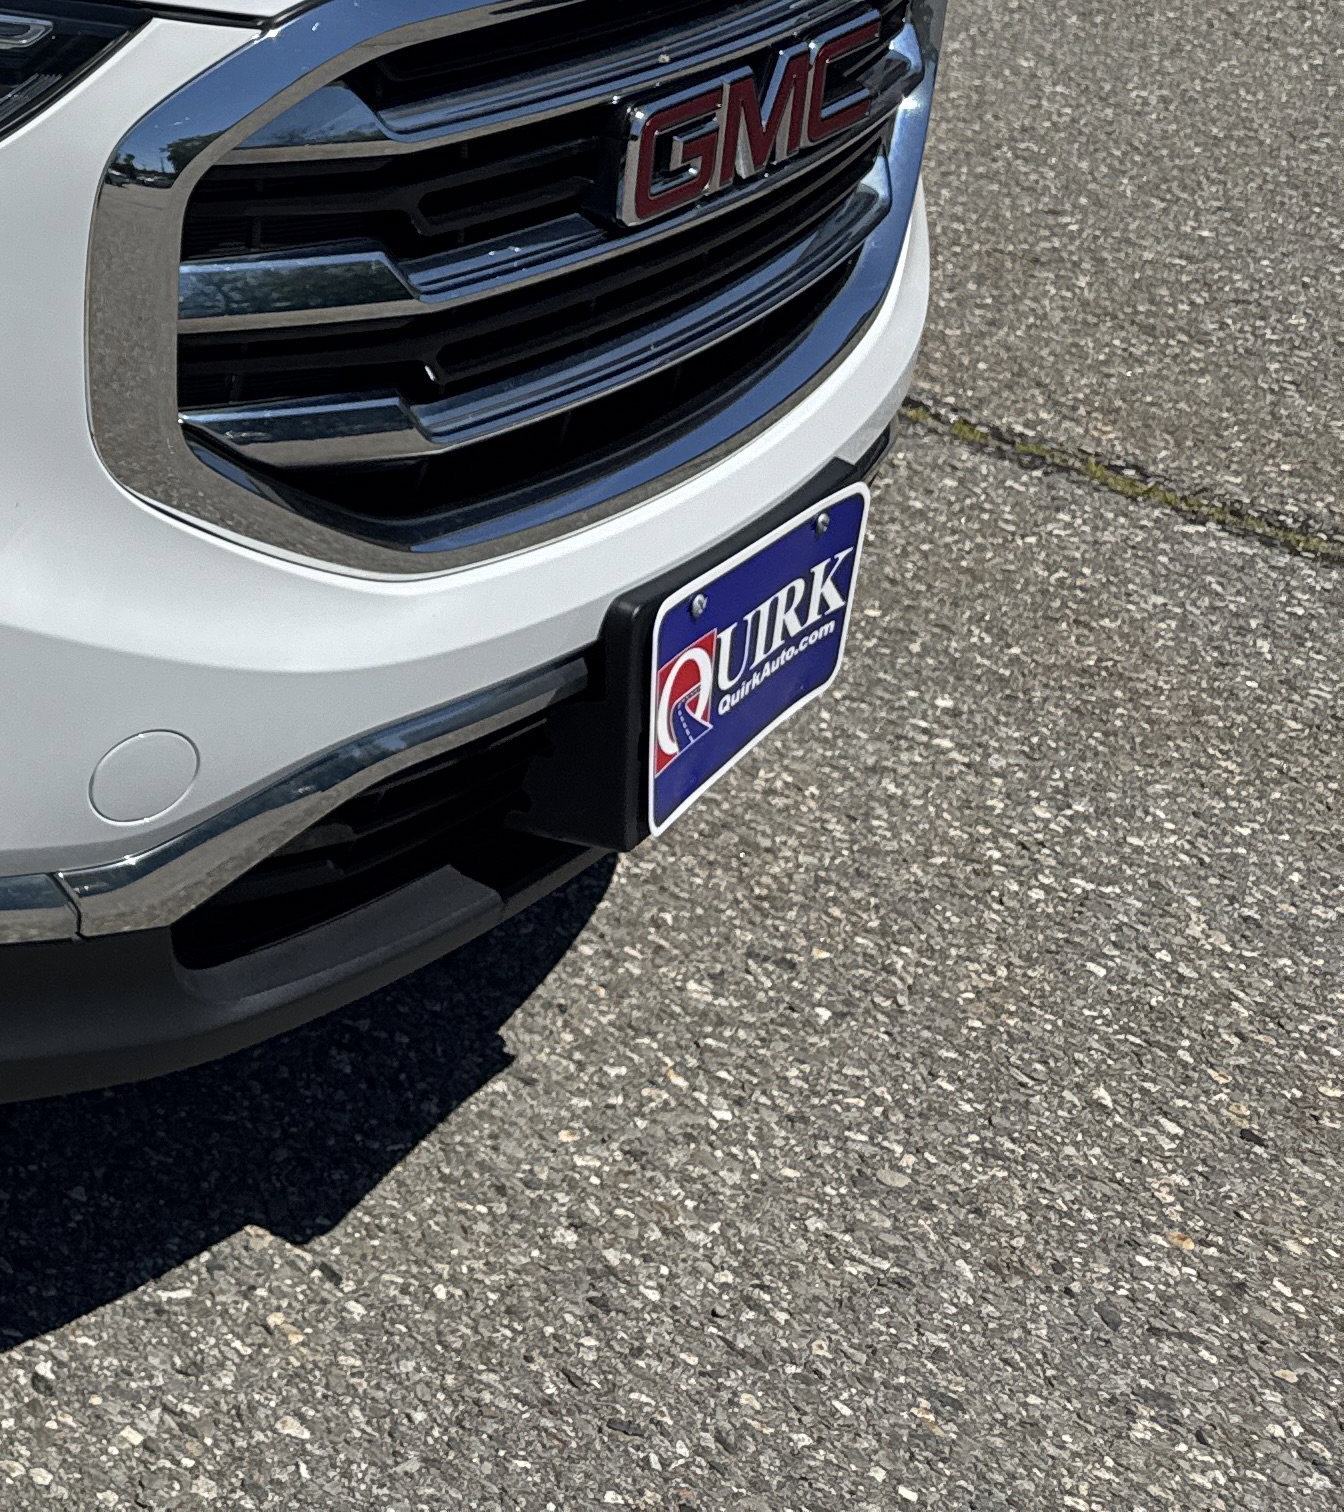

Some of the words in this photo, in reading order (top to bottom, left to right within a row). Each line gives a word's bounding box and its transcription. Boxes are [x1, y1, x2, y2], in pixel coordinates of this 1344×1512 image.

[616, 9, 881, 227] GMC
[657, 546, 854, 756] QUIRK
[717, 620, 835, 716] QuirkAuto.com
